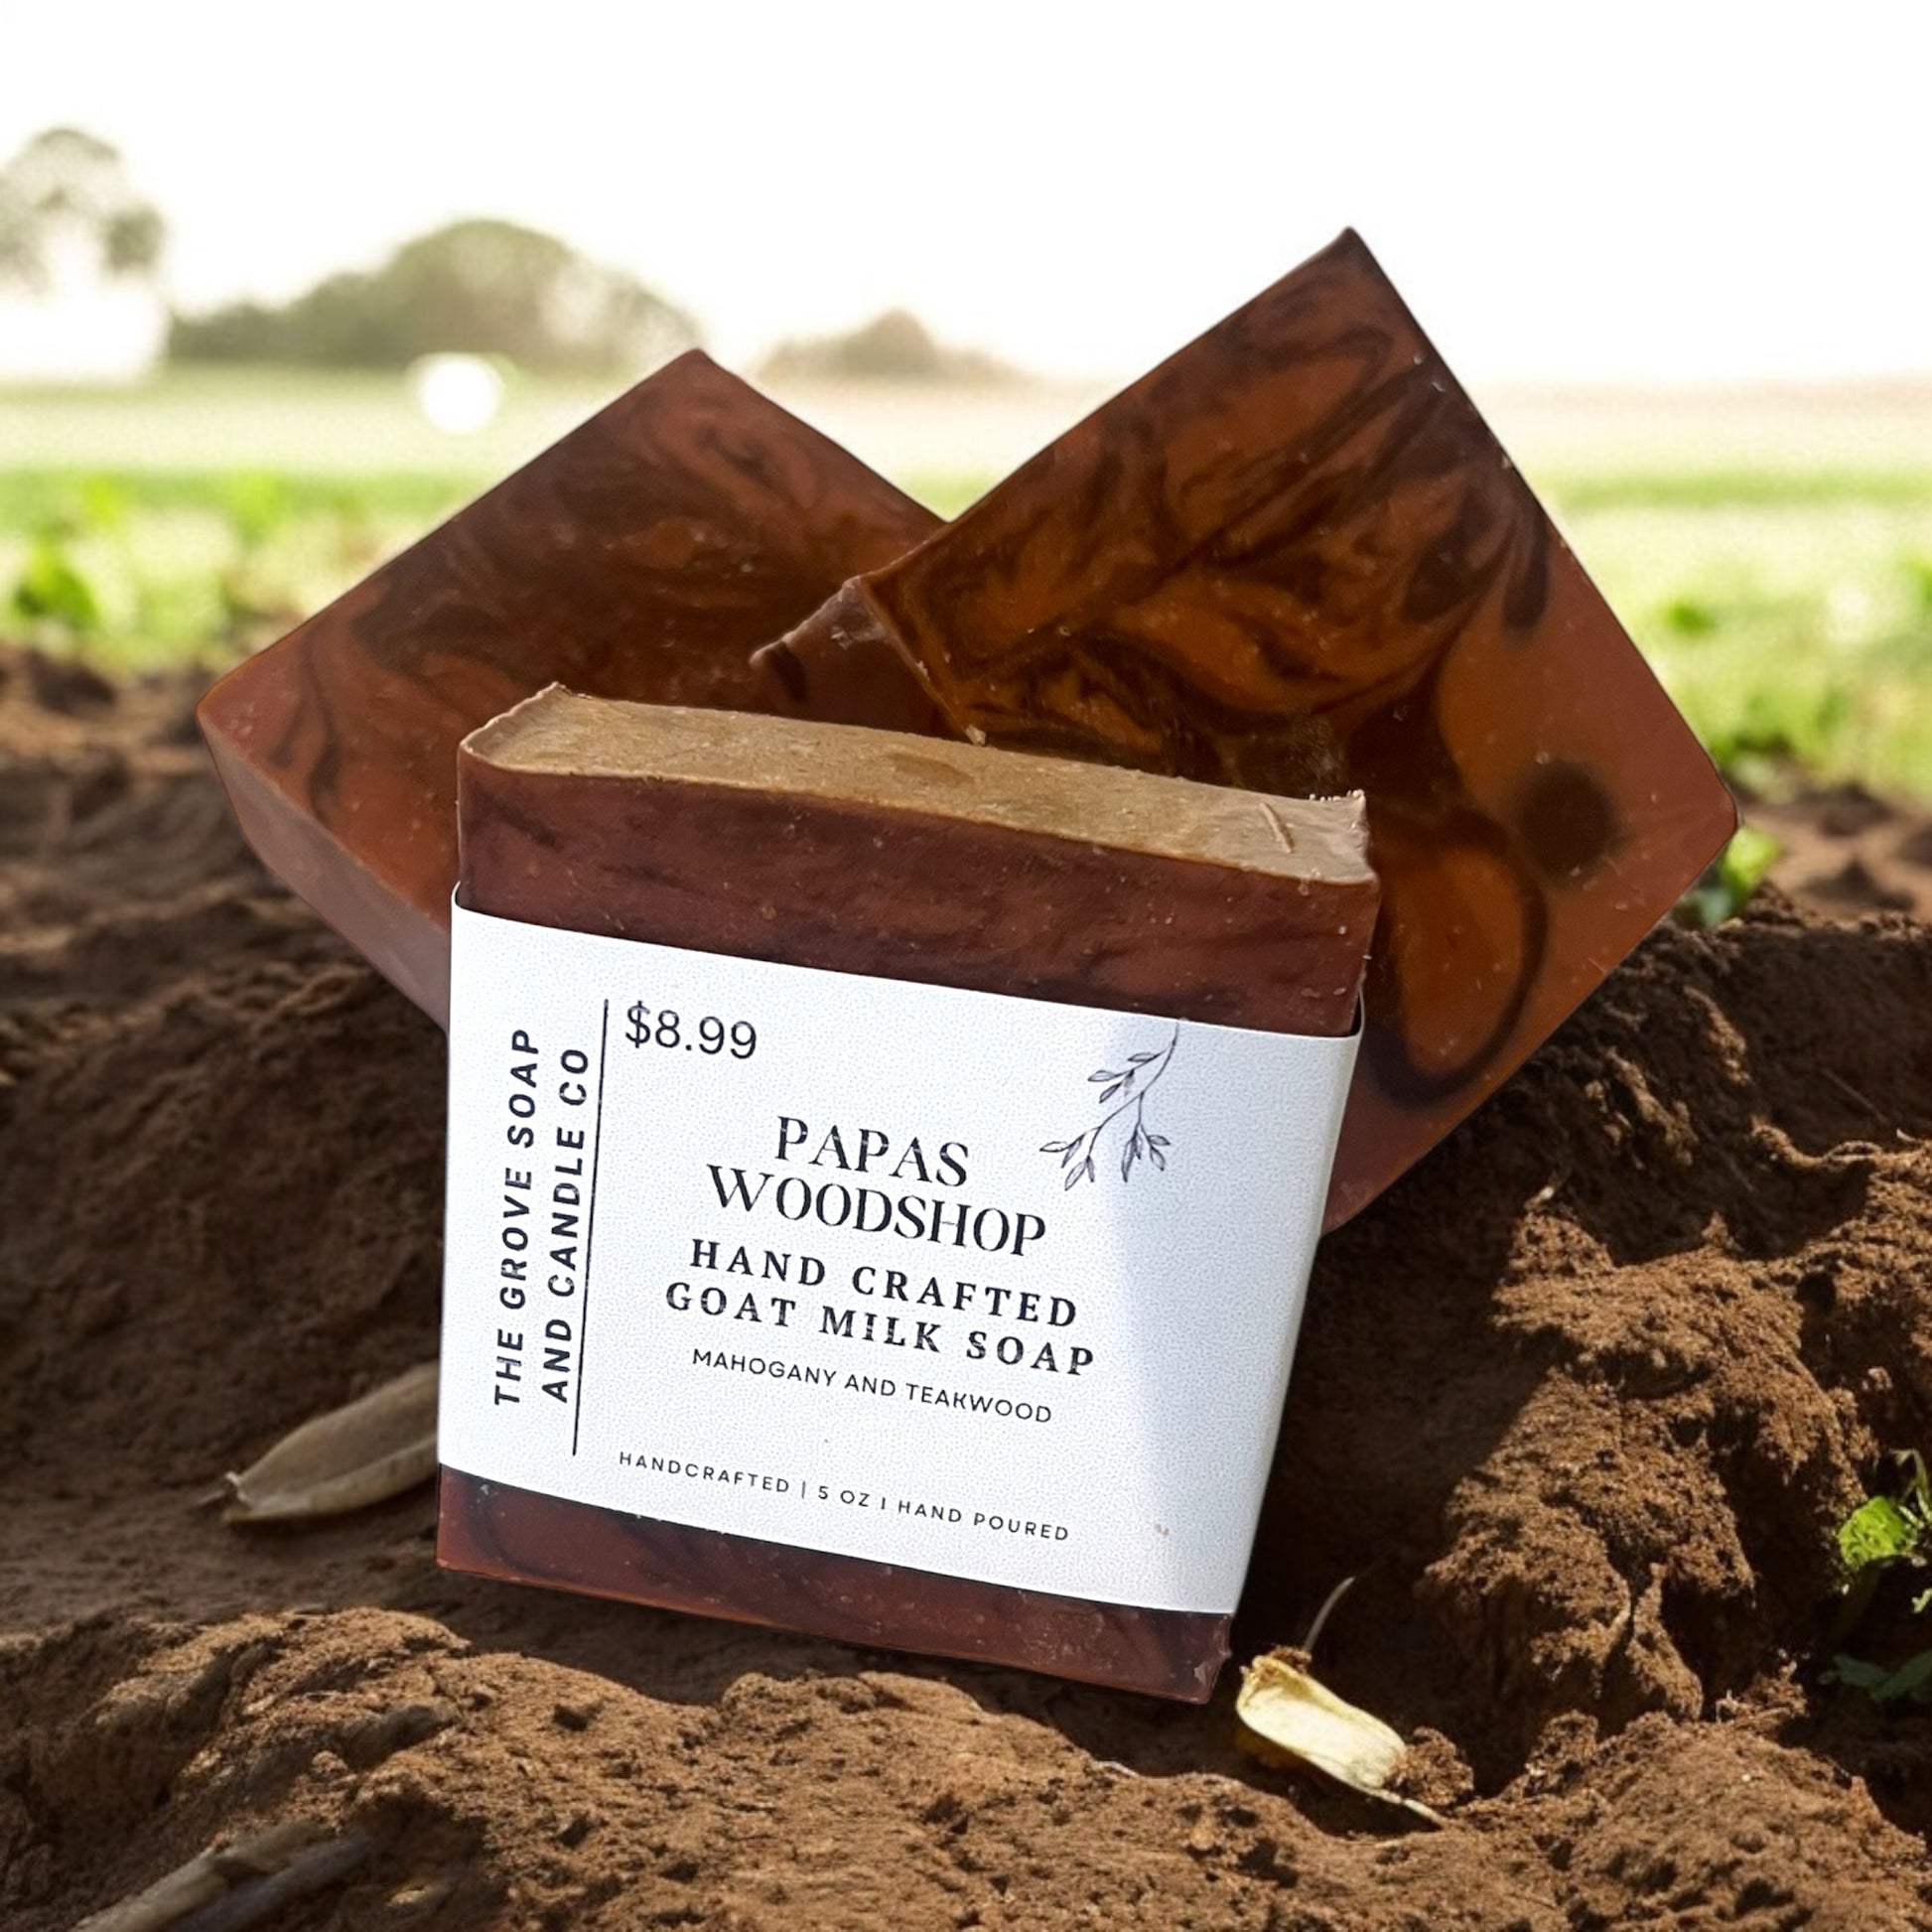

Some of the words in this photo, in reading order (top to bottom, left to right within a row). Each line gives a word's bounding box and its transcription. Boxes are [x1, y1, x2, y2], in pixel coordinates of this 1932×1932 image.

[623, 999, 758, 1060] $8.99
[508, 1029, 539, 1149] SOAP
[559, 1048, 589, 1106] CO
[774, 1116, 970, 1187] PAPAS
[499, 1167, 533, 1310] GROVE
[547, 1126, 585, 1298] CANDLE
[706, 1164, 1046, 1257] WOODSHOP
[689, 1238, 826, 1287] HAND
[851, 1266, 1076, 1327] CRAFTED
[493, 1328, 524, 1406] THE
[541, 1318, 572, 1404] AND
[665, 1282, 796, 1327] GOAT
[818, 1305, 941, 1353] MILK
[965, 1330, 1094, 1376] SOAP
[692, 1348, 837, 1387] MAHOGANY
[844, 1374, 897, 1397] AND
[905, 1382, 1051, 1423] TEAKWOOD
[619, 1450, 789, 1492] HANDCRAFTED
[818, 1485, 829, 1500] 5
[840, 1490, 870, 1507] OZ
[897, 1499, 962, 1523] HAND
[973, 1512, 1068, 1541] POURED
